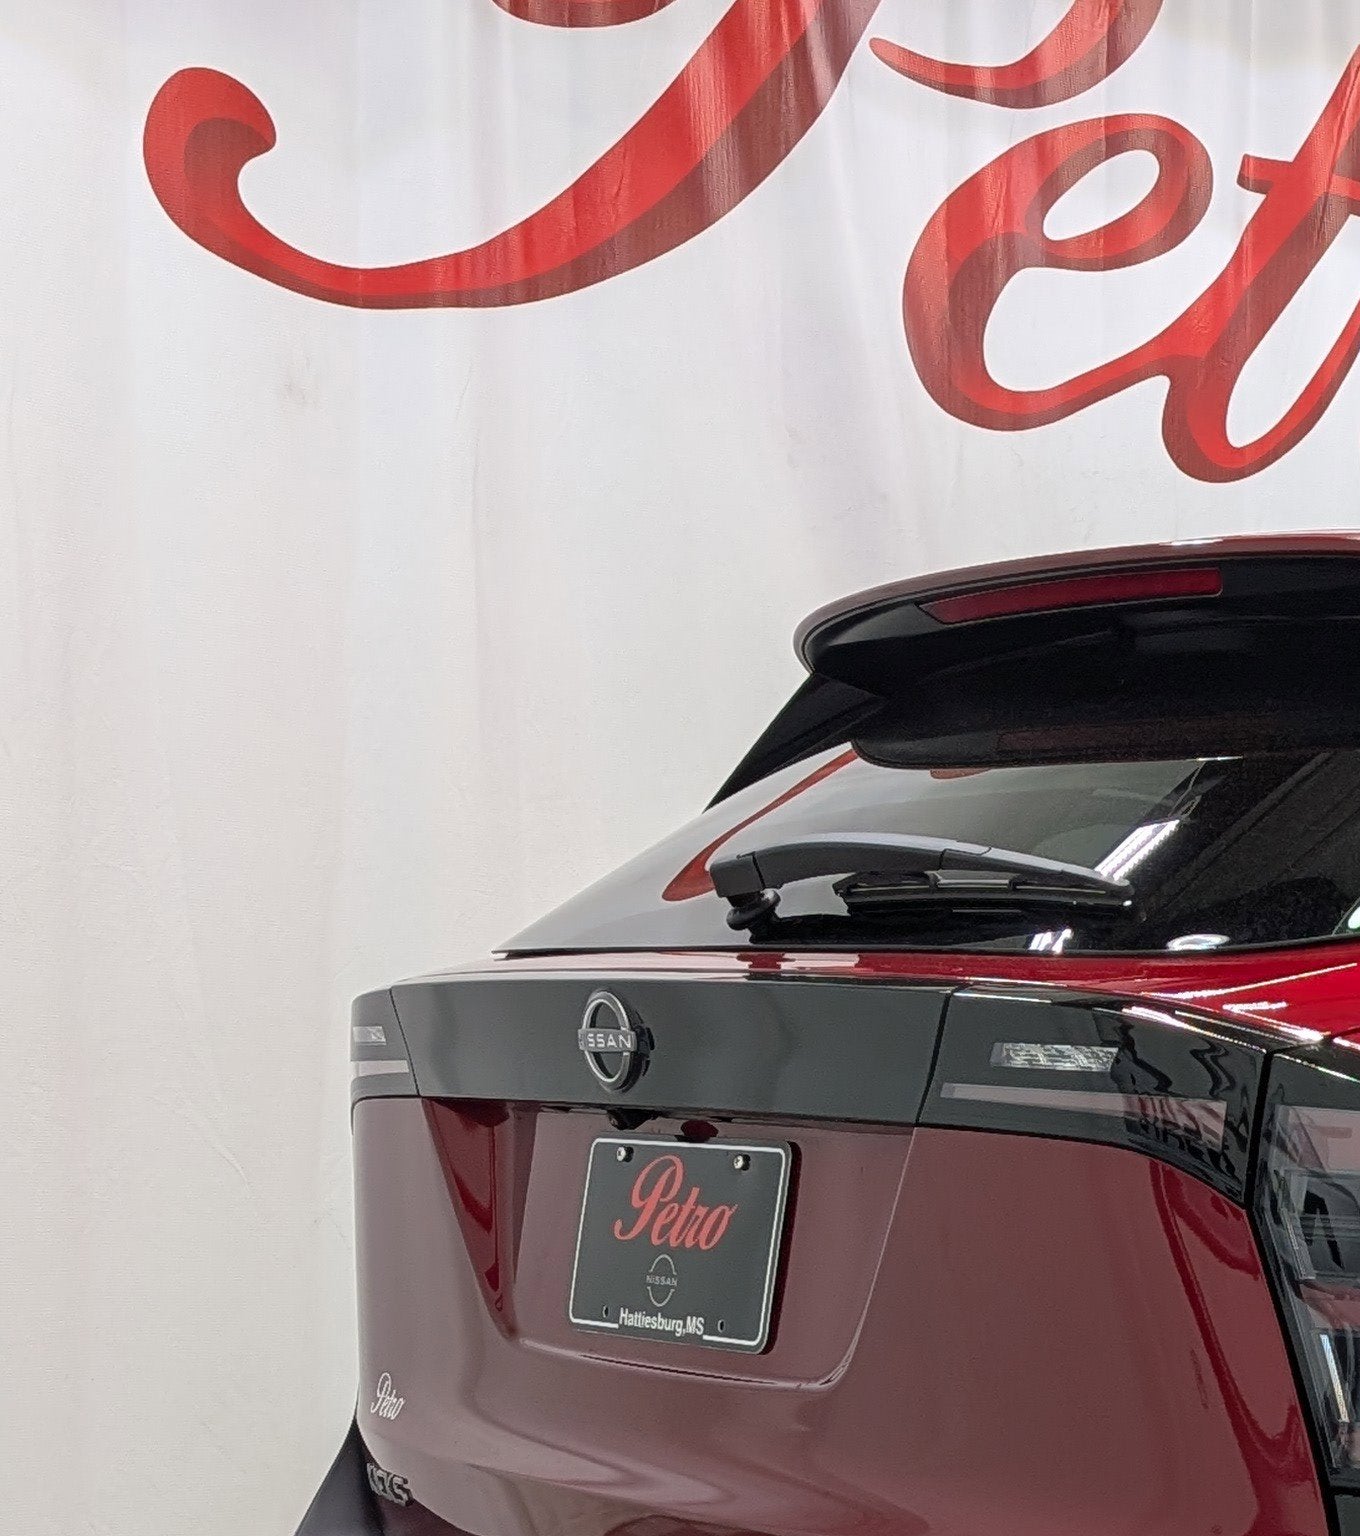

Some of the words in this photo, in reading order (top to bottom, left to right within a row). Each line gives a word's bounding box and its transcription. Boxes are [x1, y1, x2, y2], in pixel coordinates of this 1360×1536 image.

[613, 1154, 738, 1250] Petro
[646, 1273, 678, 1287] NISSAN
[619, 1307, 705, 1337] Hattiesburg,MS
